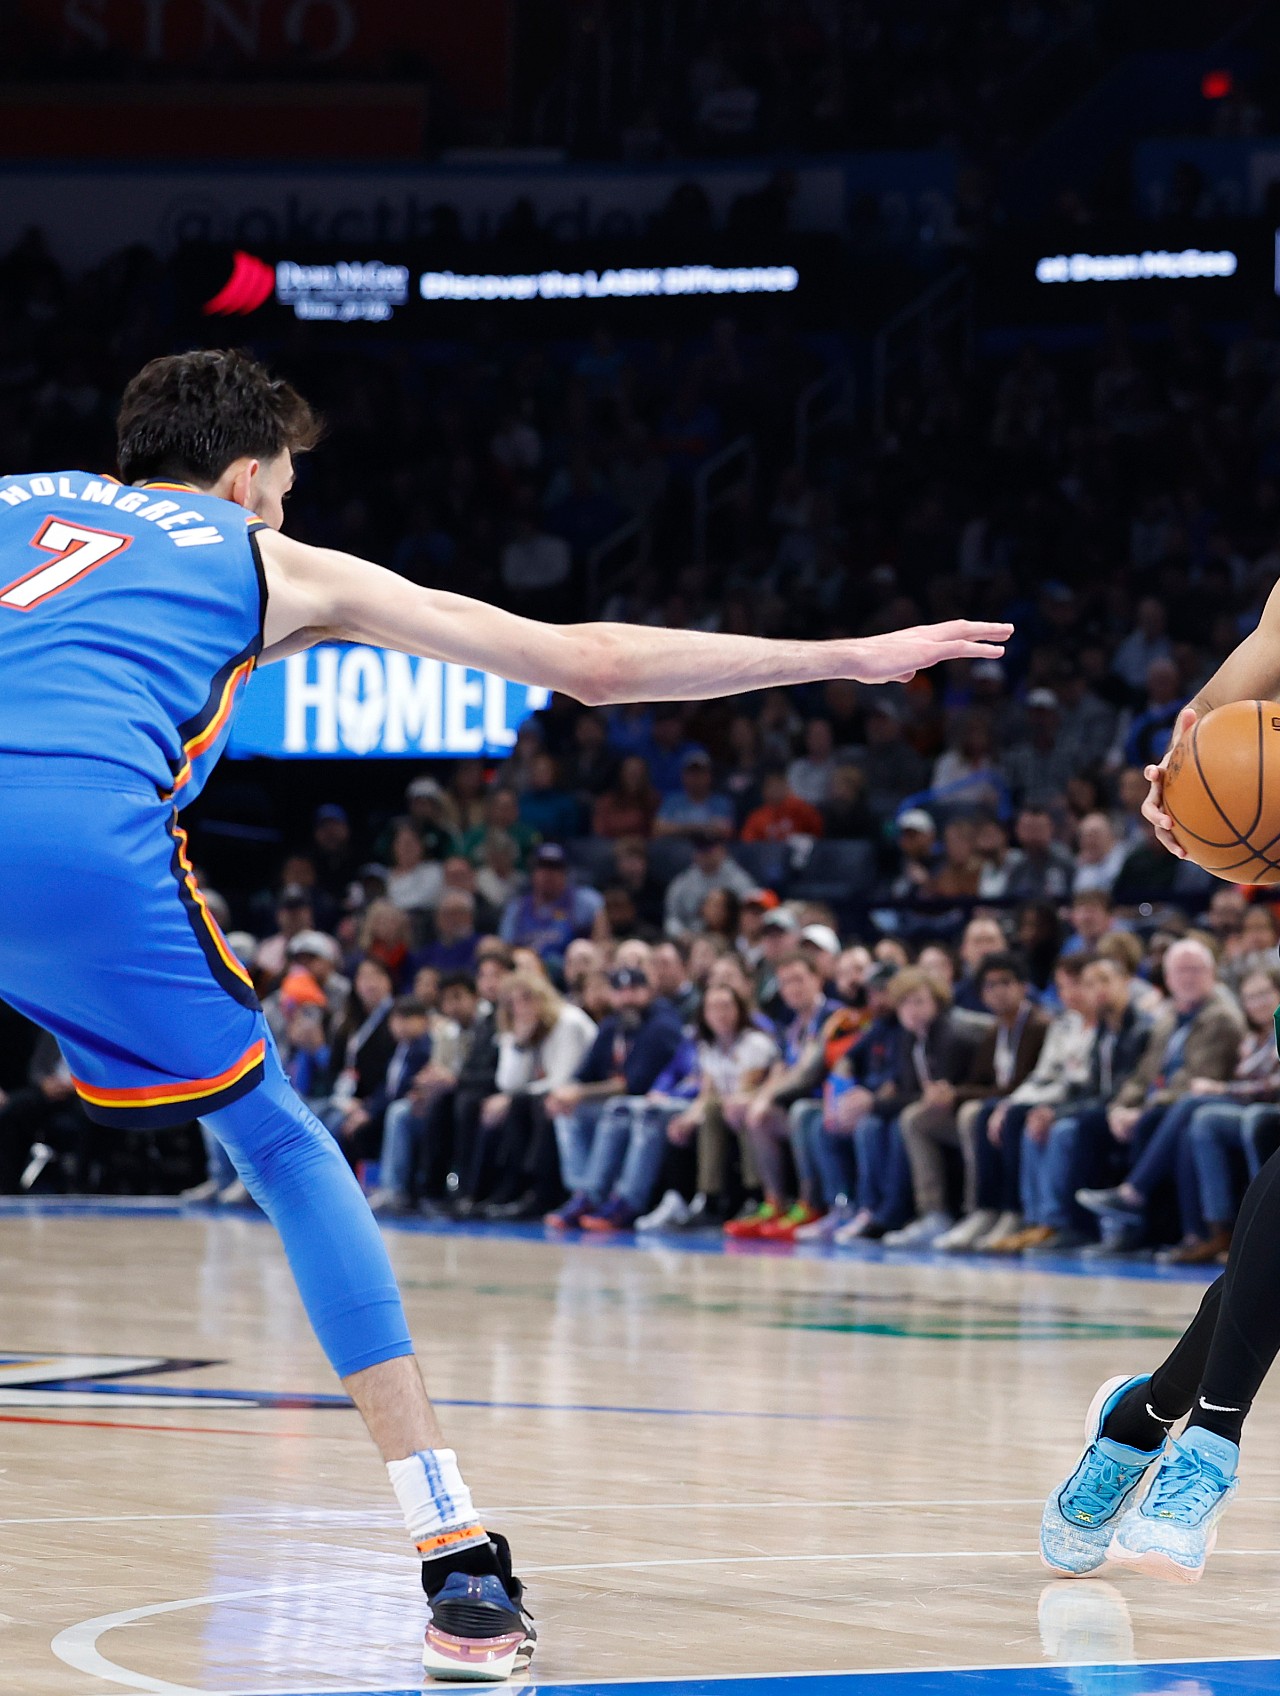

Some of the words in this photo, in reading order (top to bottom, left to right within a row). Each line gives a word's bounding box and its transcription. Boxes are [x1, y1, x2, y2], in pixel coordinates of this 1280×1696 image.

[0, 477, 224, 547] HOLMGREN
[0, 514, 135, 612] 7
[284, 646, 548, 755] HOMEL
